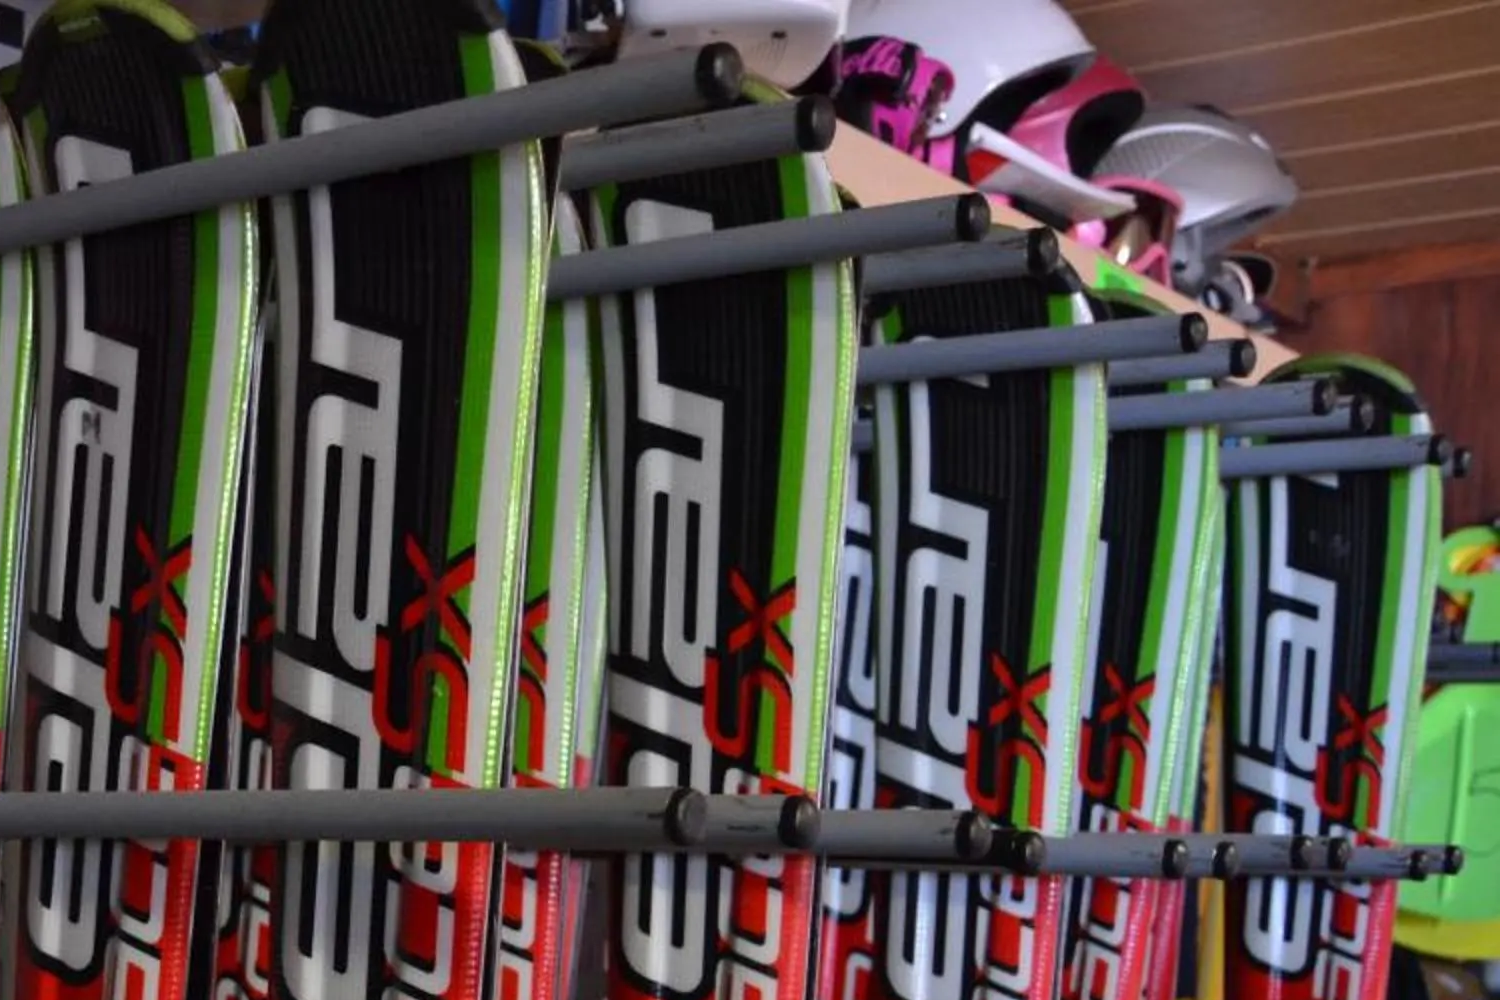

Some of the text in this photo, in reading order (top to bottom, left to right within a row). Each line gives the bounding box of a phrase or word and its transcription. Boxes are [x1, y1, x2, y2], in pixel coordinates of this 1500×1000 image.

[25, 135, 139, 969] elan
[607, 199, 725, 995] elan
[1233, 472, 1336, 973] elan
